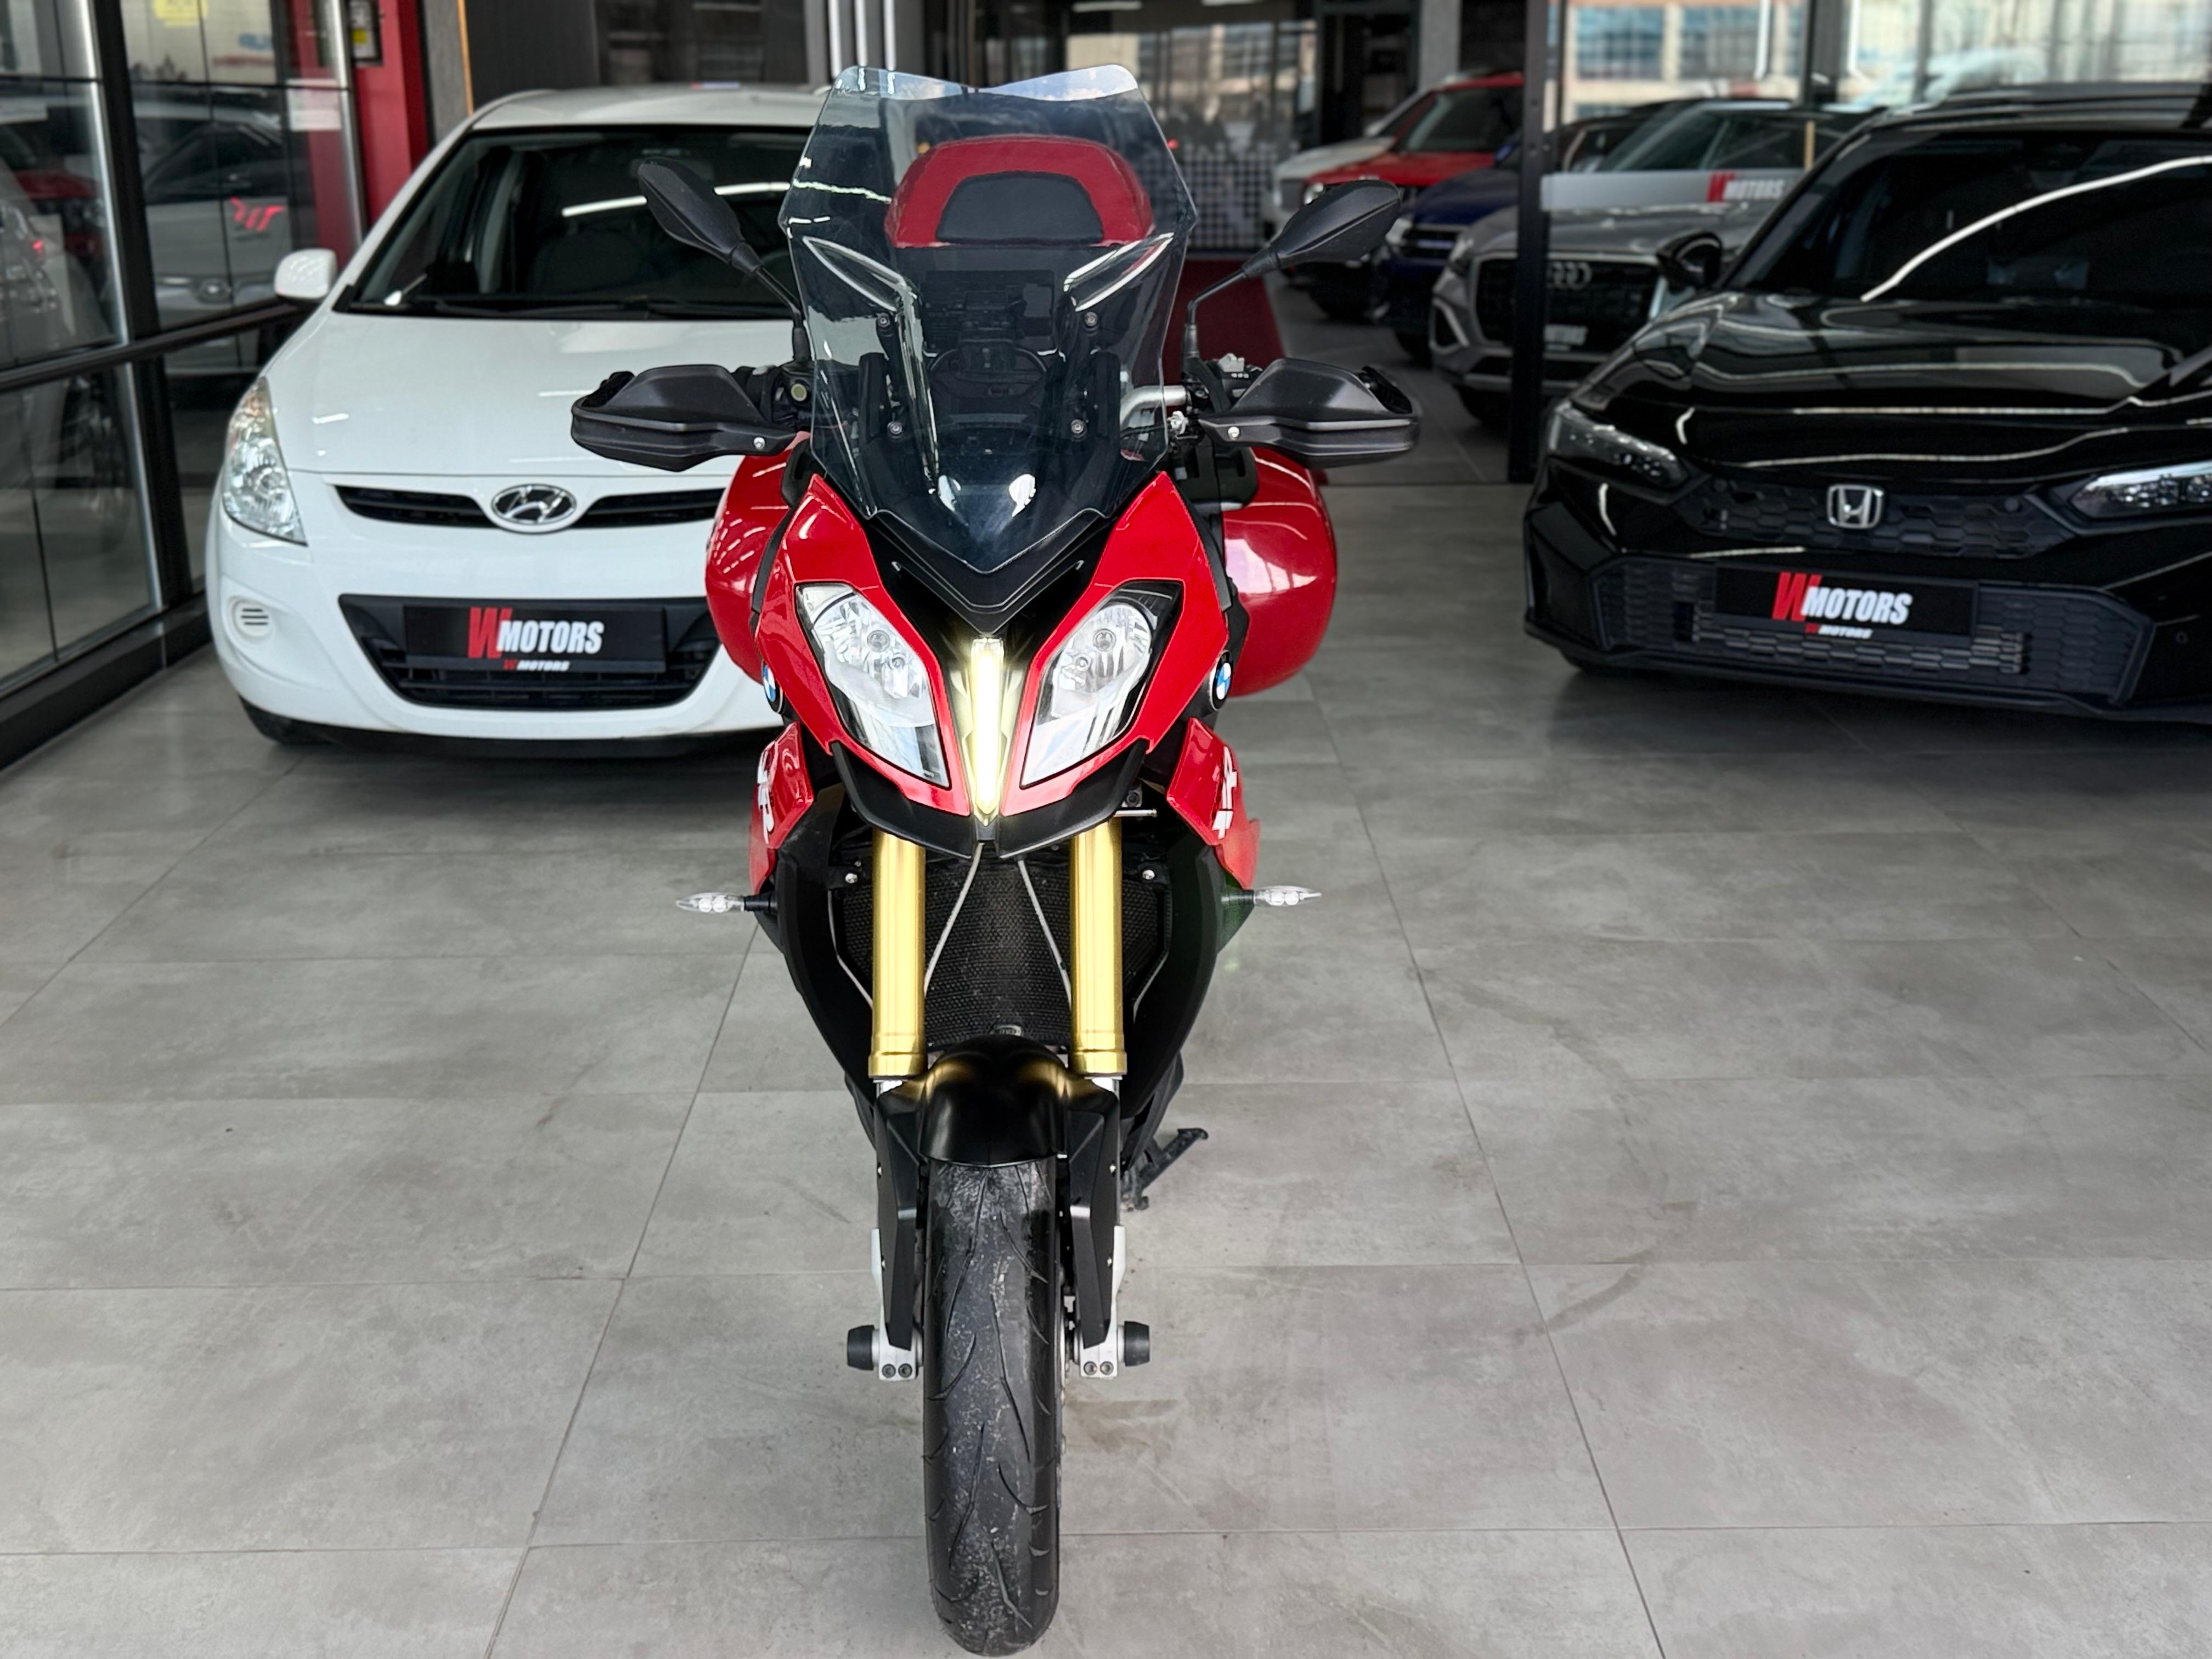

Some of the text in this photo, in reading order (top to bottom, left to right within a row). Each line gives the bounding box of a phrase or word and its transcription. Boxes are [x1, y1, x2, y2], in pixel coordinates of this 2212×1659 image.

[1801, 586, 1913, 625] MOTORS
[496, 620, 604, 654] MOTORS
[517, 659, 571, 672] MOTORS
